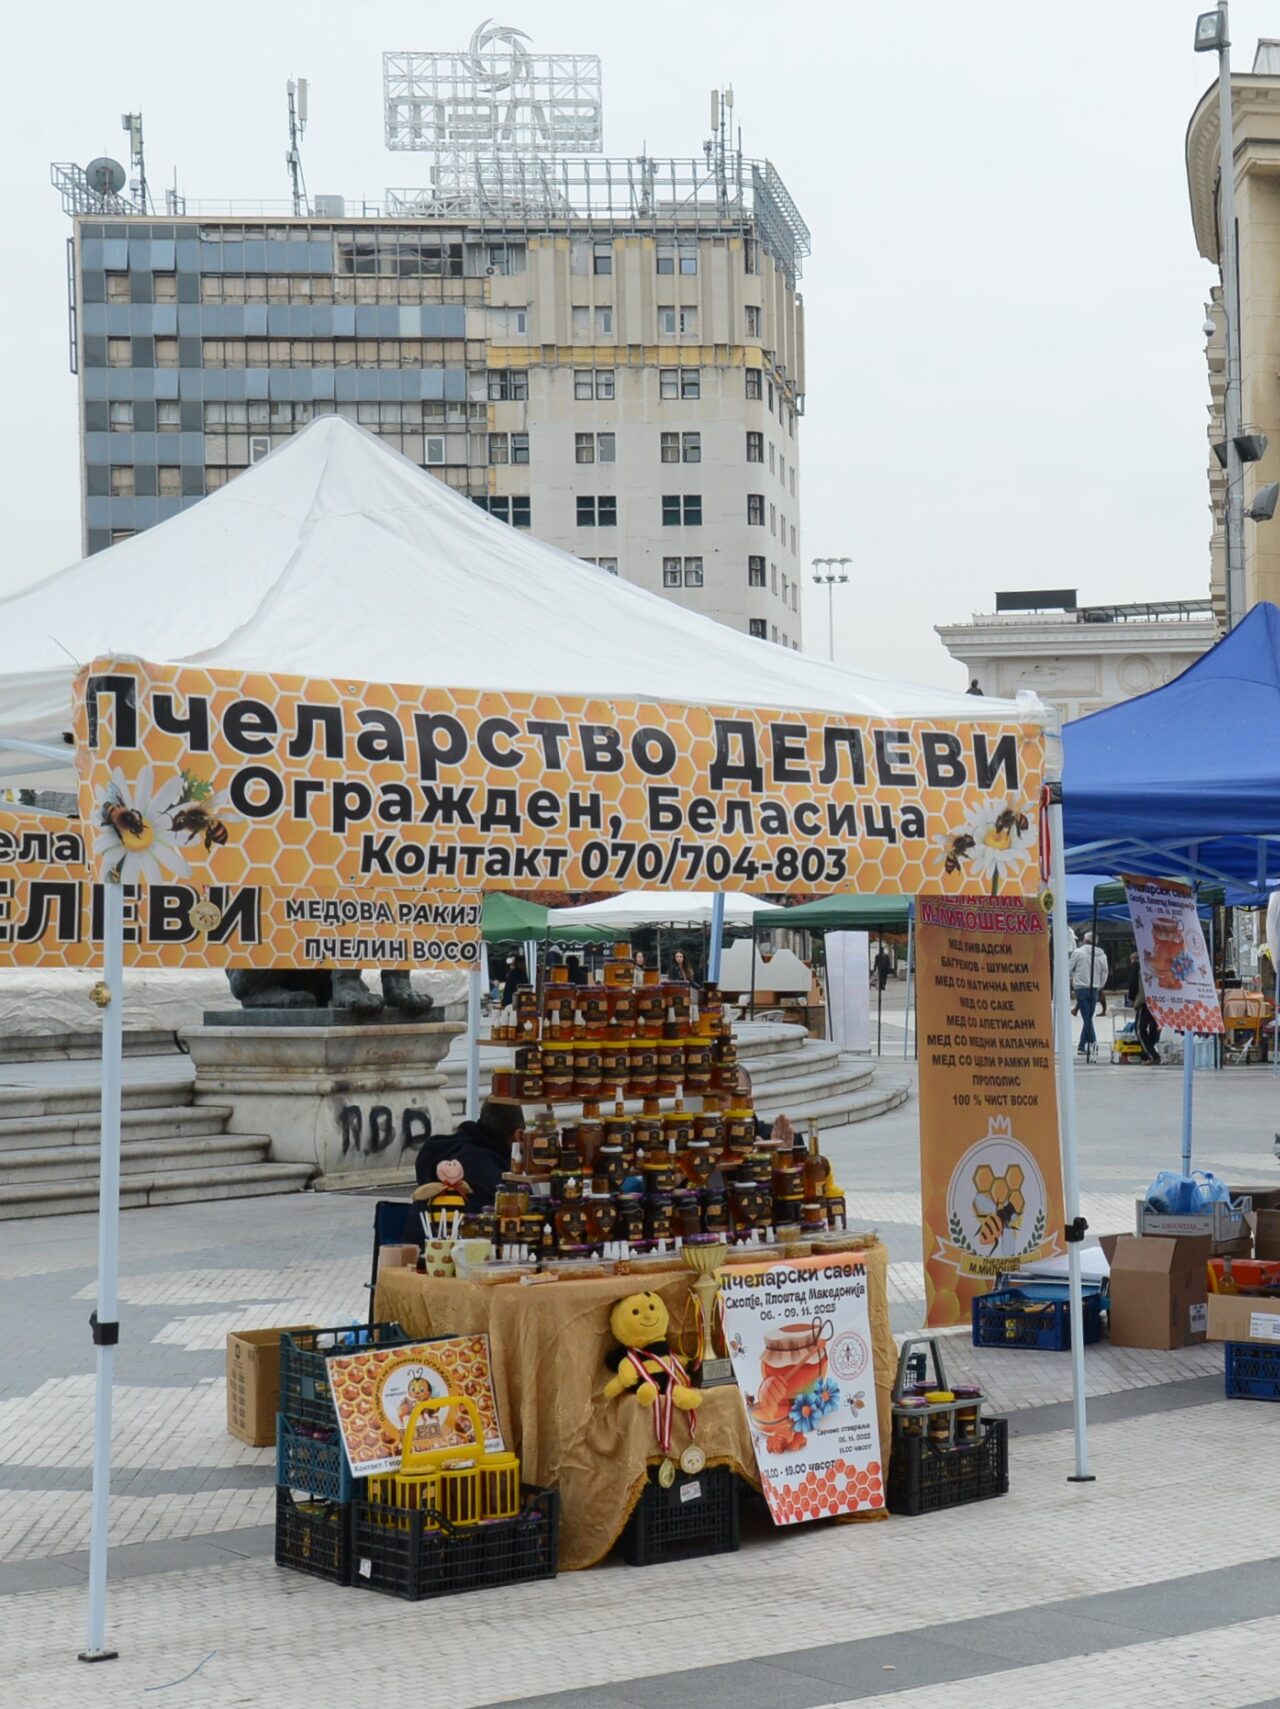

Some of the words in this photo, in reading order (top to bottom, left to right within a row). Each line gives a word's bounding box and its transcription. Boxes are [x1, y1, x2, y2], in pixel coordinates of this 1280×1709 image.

[87, 675, 678, 782] Пчеларство
[709, 718, 1020, 793] ДЕЛЕВИ
[229, 765, 623, 839] Огражден,
[648, 785, 926, 843] Беласица
[360, 834, 568, 878] Контакт
[581, 836, 848, 885] 070/704-803
[285, 898, 397, 924] МЕДОВА
[402, 901, 483, 926] РАКИЈ
[304, 937, 405, 963] ПЧЕЛИН
[948, 939, 964, 953] МЕД
[964, 941, 1013, 955] ЛИВАДСКИ
[987, 962, 1029, 974] ШУМСКИ
[935, 975, 955, 988] МЕД
[956, 978, 966, 989] СО
[966, 980, 1009, 992] МАТИЧНА
[1010, 981, 1040, 992] МЛЕЧ
[960, 996, 976, 1010] МЕД
[977, 999, 988, 1010] СО
[990, 1000, 1015, 1012] САКЕ
[947, 1015, 967, 1027] МЕД
[967, 1017, 978, 1027] СО
[927, 1034, 951, 1047] МЕД
[954, 1035, 967, 1047] СО
[969, 1037, 998, 1048] МЕДНИ
[932, 1054, 956, 1067] МЕД
[958, 1055, 972, 1067] СО
[974, 1056, 997, 1068] ЦЕЛИ
[999, 1056, 1030, 1068] РАМКИ
[1032, 1057, 1049, 1068] МЕД
[972, 1074, 1021, 1087] ПРОПОЛИС
[953, 1094, 970, 1106] 100
[974, 1095, 982, 1106] %
[984, 1095, 1009, 1106] ЧИСТ
[1011, 1095, 1039, 1107] ВОСОК
[720, 1266, 819, 1291] Пчеларски
[823, 1262, 866, 1278] саем
[725, 1294, 763, 1310] Скопје,
[765, 1291, 808, 1305] Плоштад
[808, 1282, 865, 1302] Македонија
[760, 1310, 776, 1321] 06.
[784, 1308, 799, 1319] 09.
[801, 1307, 812, 1317] 11.
[384, 1459, 402, 1470] Геор
[785, 1463, 807, 1476] 19.00
[808, 1460, 836, 1472] часот
